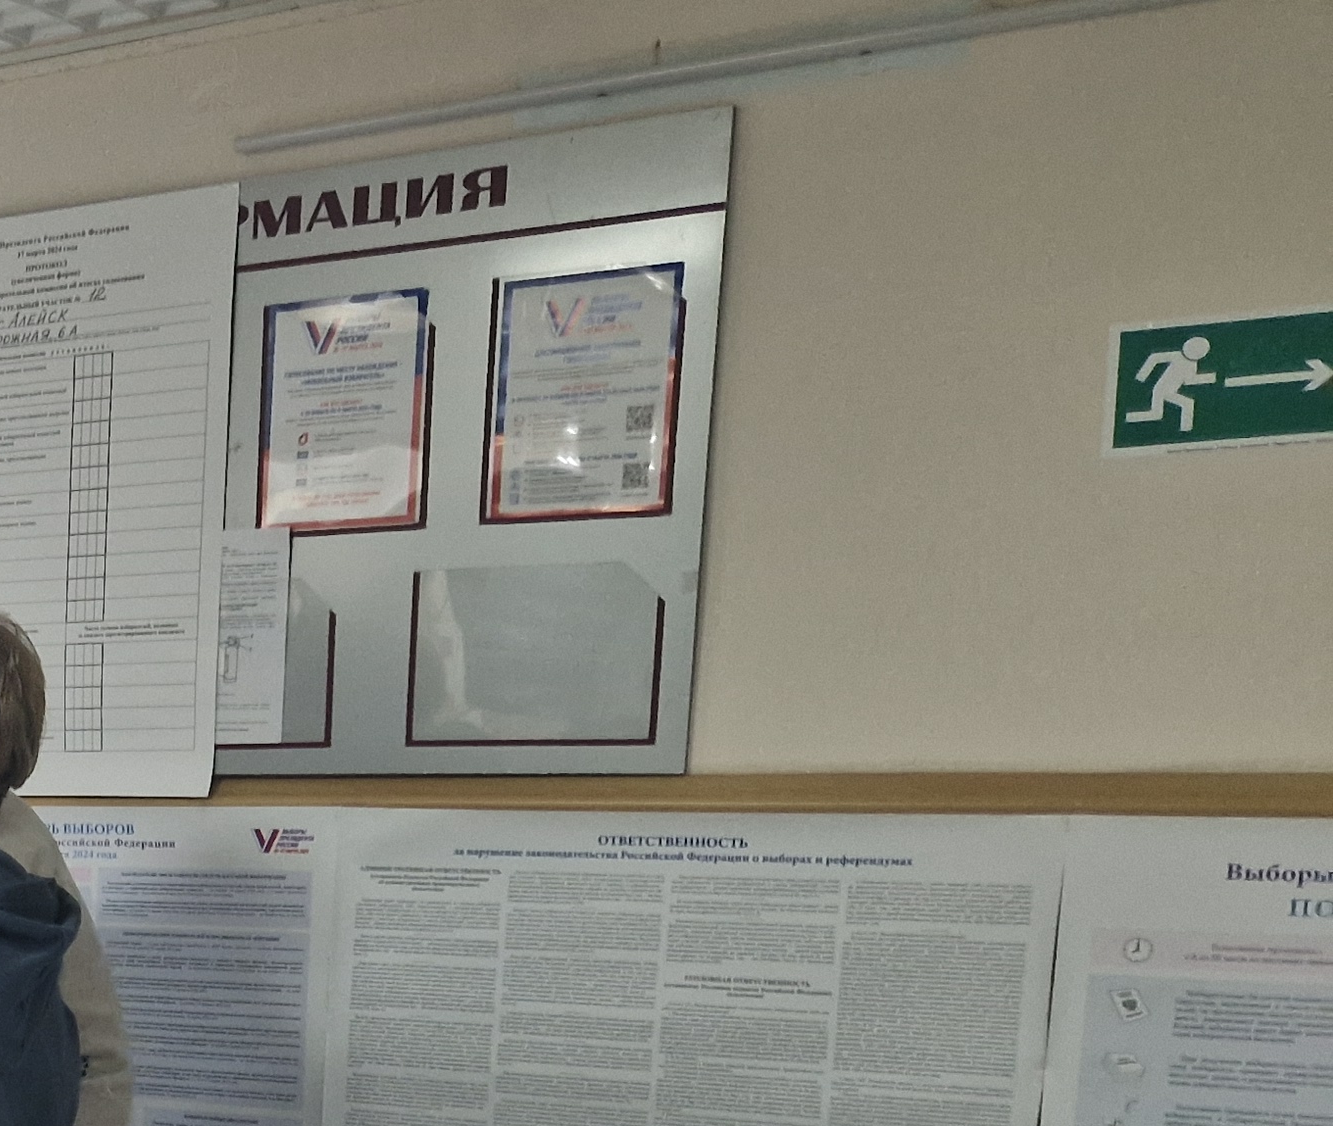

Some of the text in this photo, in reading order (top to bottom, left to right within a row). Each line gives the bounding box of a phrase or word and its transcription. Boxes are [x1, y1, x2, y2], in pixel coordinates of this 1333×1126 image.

[63, 823, 135, 835] ВЫБОРОВ
[114, 838, 176, 850] Федерации
[597, 835, 749, 849] ОТВЕТСТВЕННОСТЬ
[620, 850, 684, 862] Российской
[686, 852, 749, 864] Федерации
[762, 853, 812, 866] выборах
[825, 855, 913, 868] референдумах
